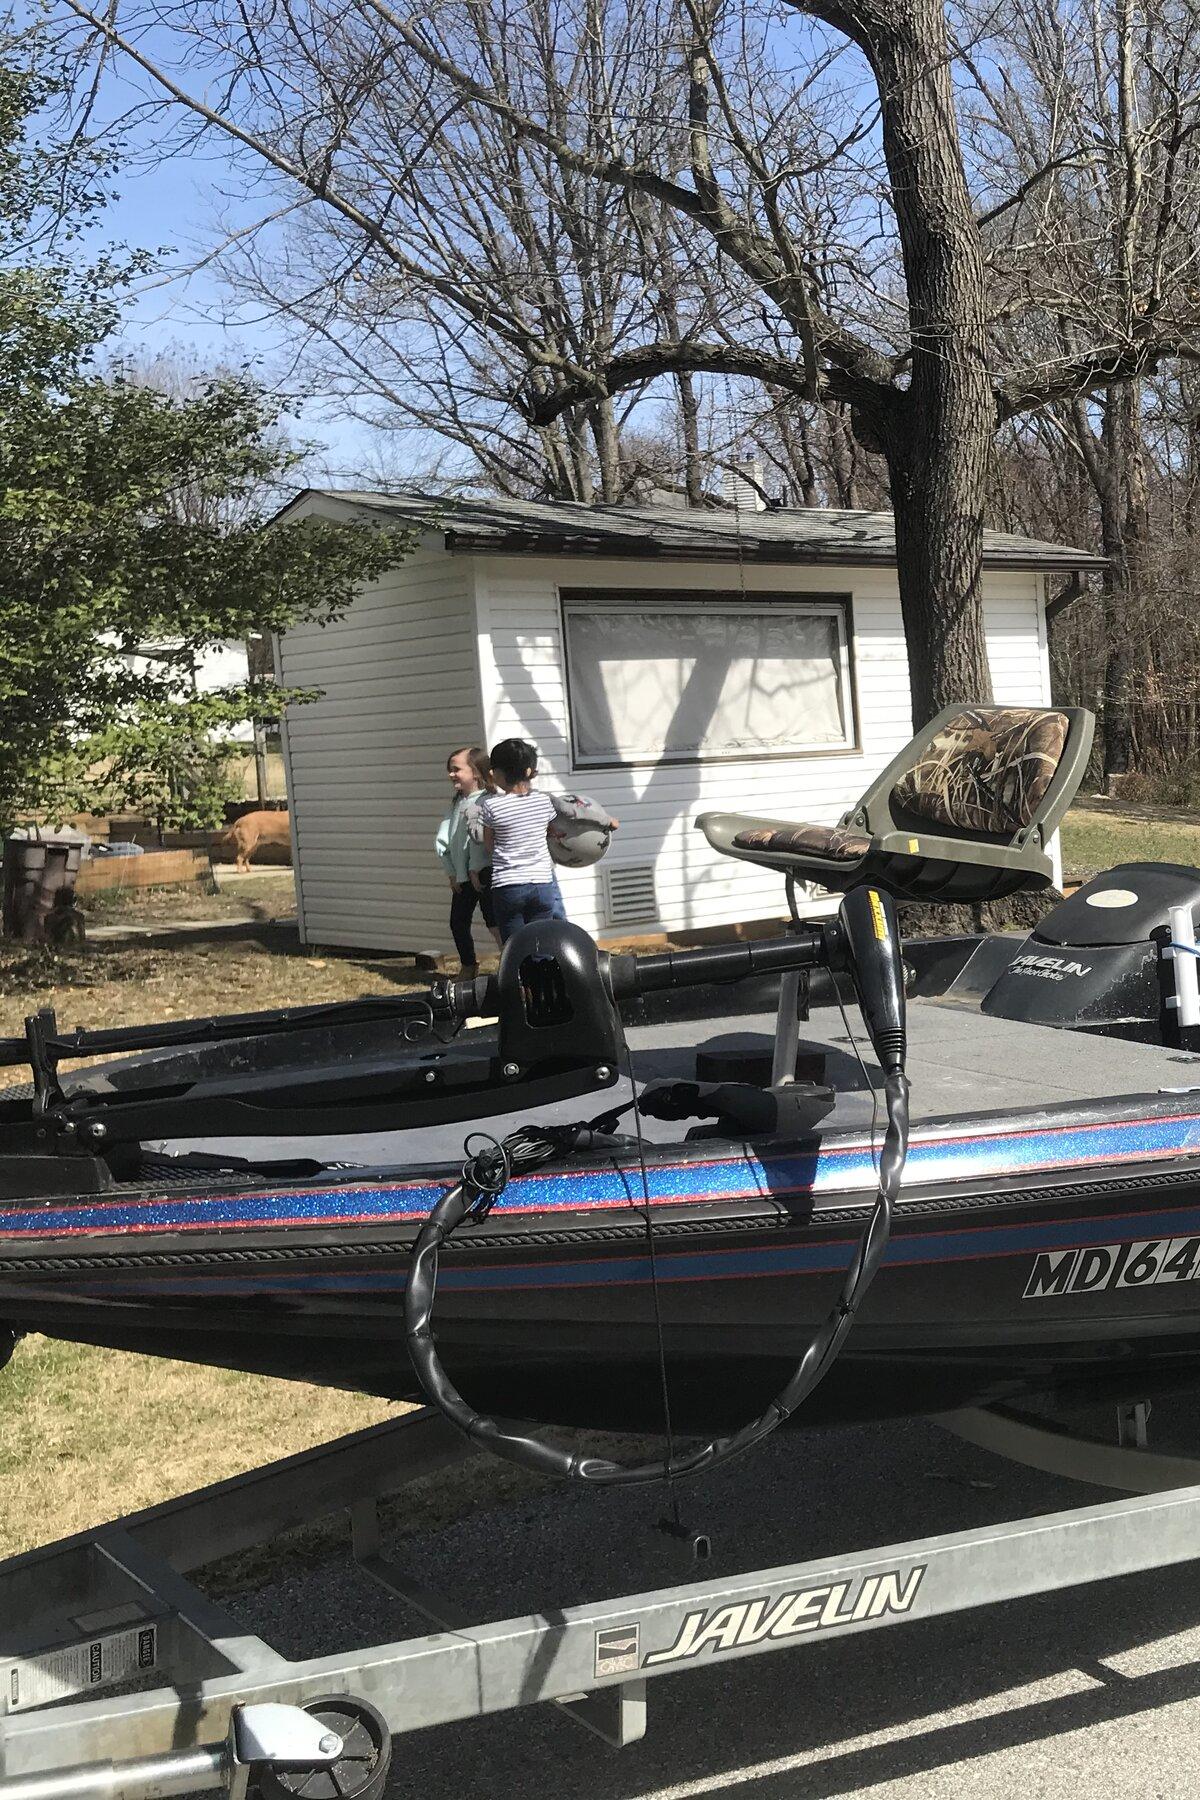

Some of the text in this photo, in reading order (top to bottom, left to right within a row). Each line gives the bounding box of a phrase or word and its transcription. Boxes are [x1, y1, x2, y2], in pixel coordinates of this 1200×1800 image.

[1008, 955, 1093, 976] JAVELIN
[1031, 1246, 1113, 1297] MD
[641, 1564, 928, 1668] JAVELIN
[91, 1644, 101, 1682] CAUTION
